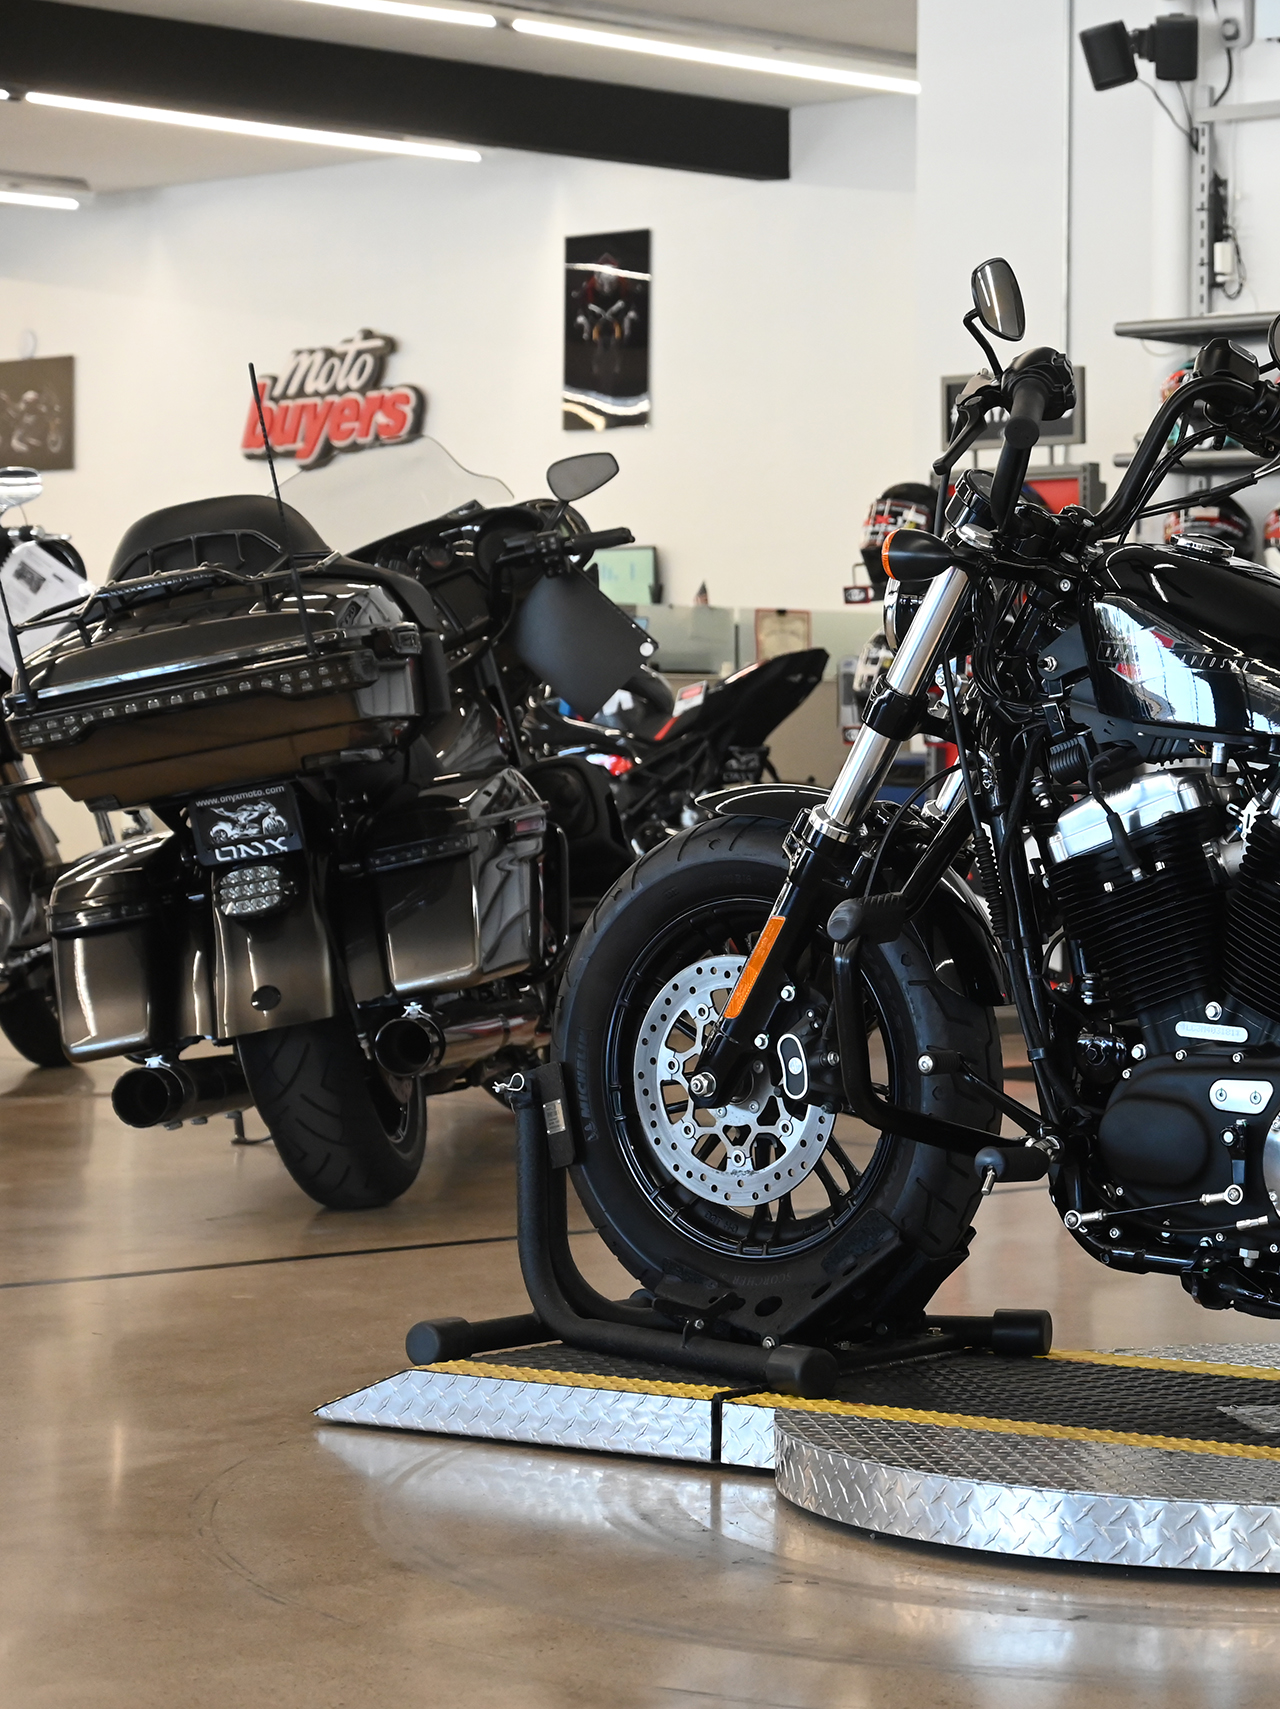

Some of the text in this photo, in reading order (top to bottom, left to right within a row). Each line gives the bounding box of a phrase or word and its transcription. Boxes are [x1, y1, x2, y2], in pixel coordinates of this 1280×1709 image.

[241, 378, 414, 462] buyers
[195, 785, 285, 807] www.onyxmoto.com
[214, 836, 288, 861] ONYX
[576, 1028, 591, 1118] MICHELIN
[732, 1271, 792, 1287] SCORCHER
